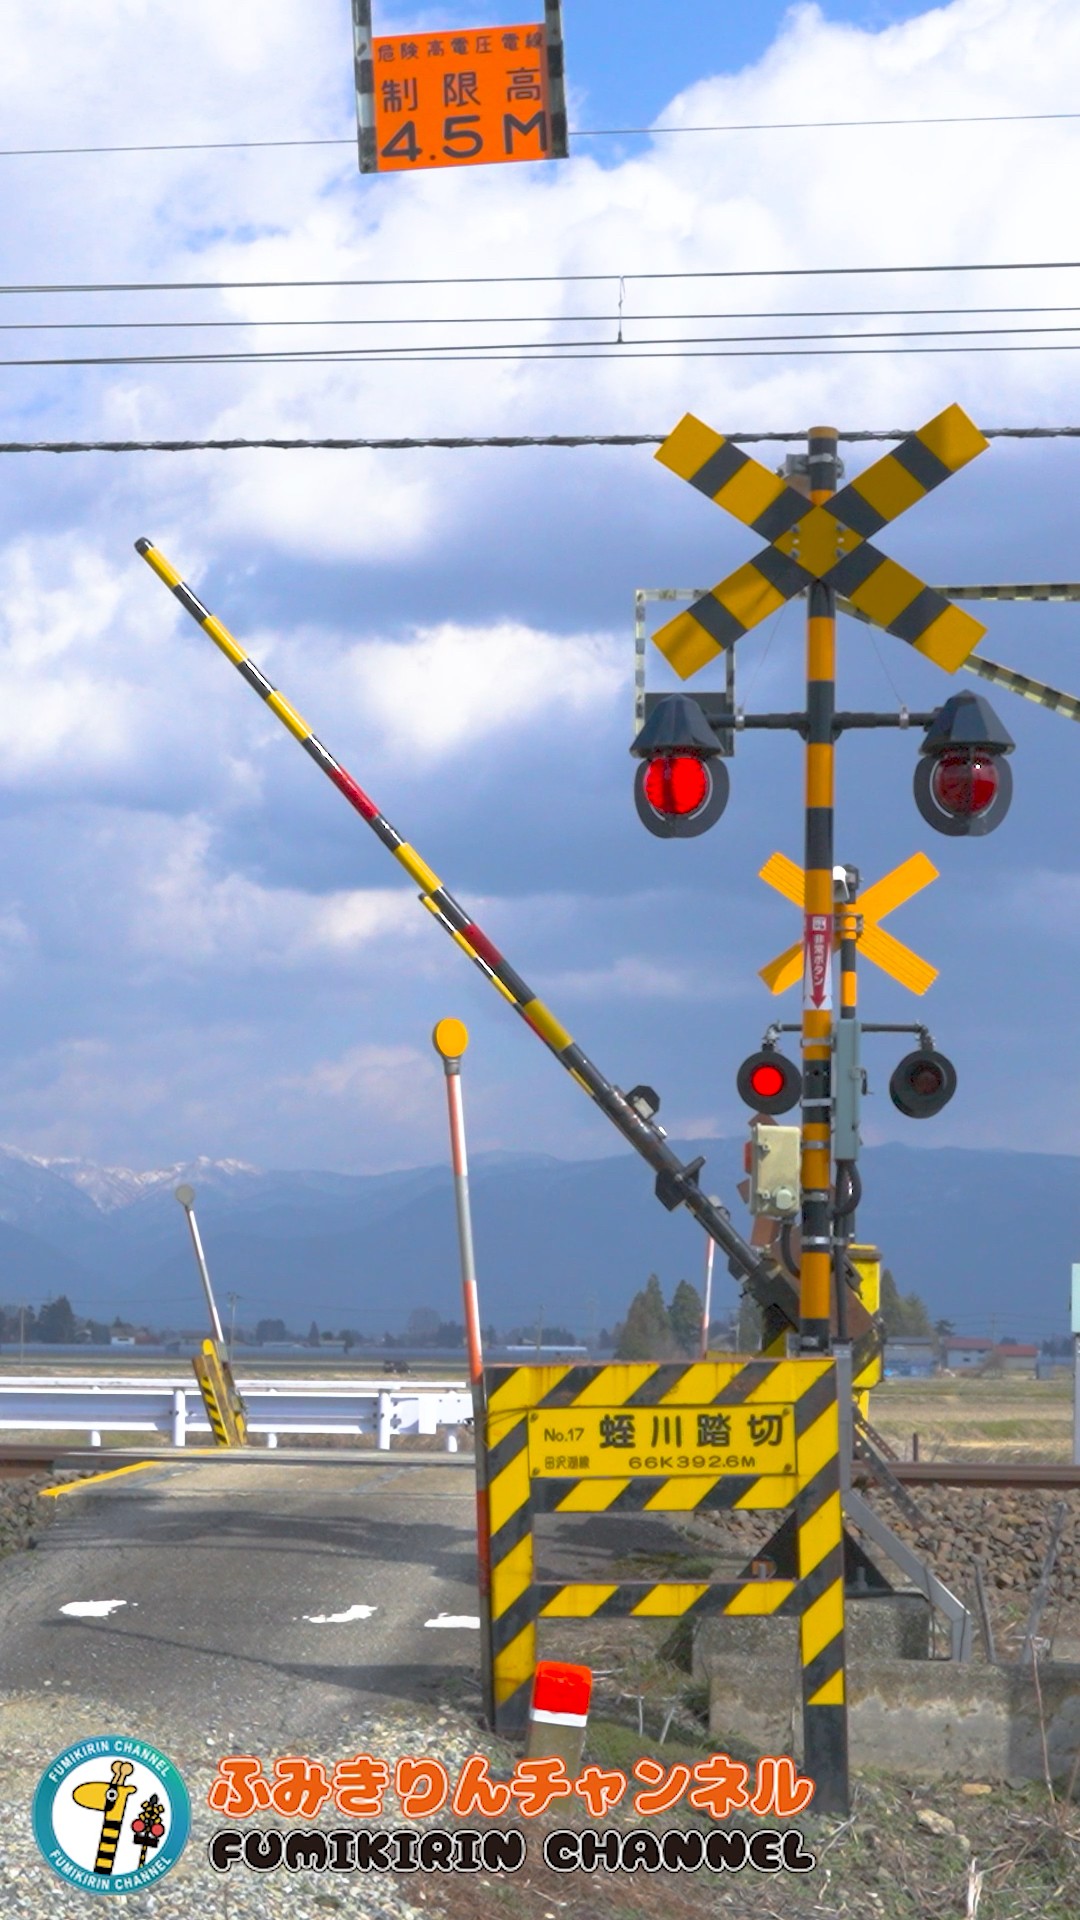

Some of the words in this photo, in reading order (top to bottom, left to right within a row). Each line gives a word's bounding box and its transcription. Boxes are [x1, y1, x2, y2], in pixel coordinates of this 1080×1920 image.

[381, 67, 541, 113] 制限高
[381, 110, 548, 162] 4.5M
